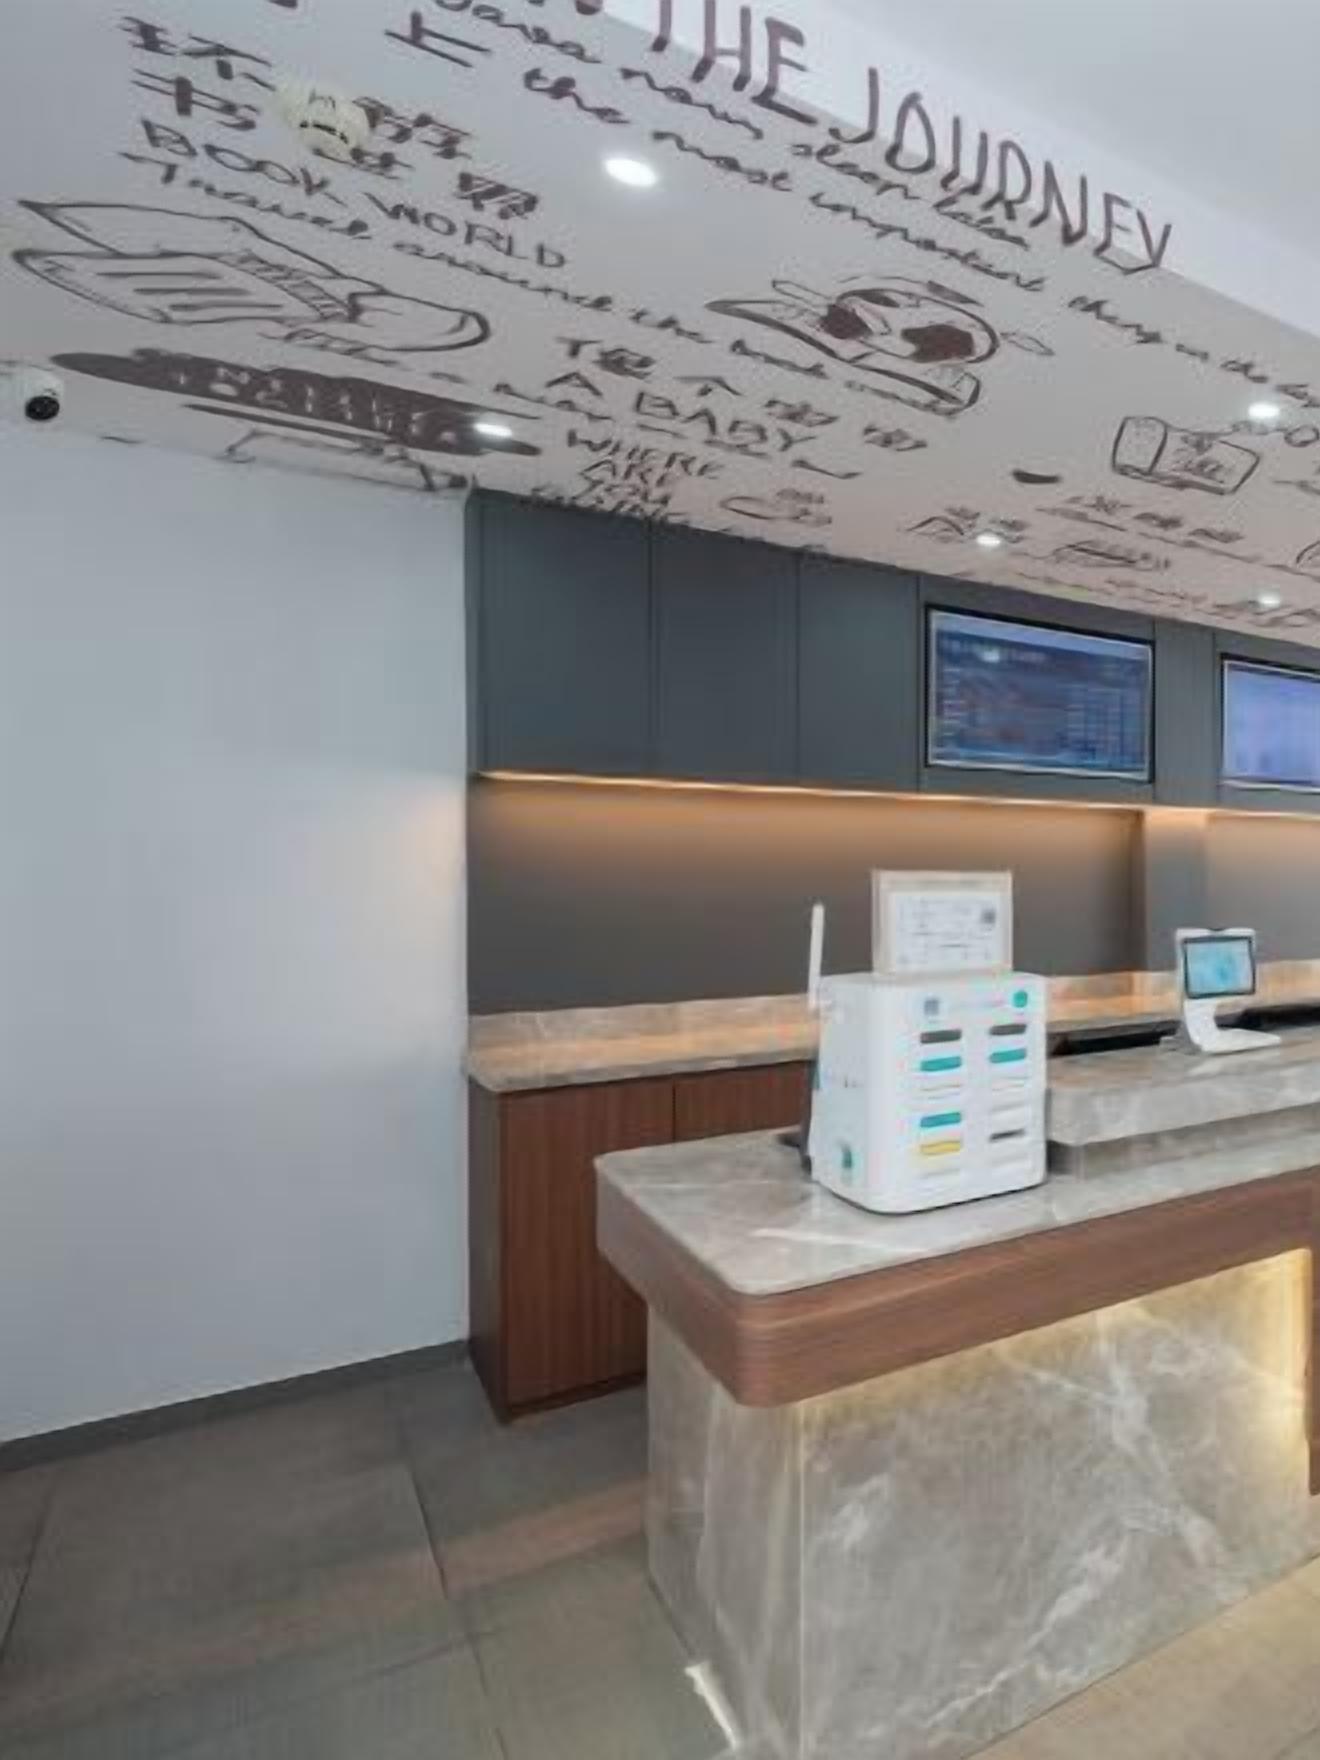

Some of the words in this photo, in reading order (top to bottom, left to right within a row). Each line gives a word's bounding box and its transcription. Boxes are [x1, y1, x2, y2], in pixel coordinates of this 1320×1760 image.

[138, 116, 349, 207] BOOK
[362, 191, 568, 269] WORLD
[828, 66, 1173, 276] JOURNEY
[566, 429, 728, 482] WHERE
[632, 390, 819, 452] BABY
